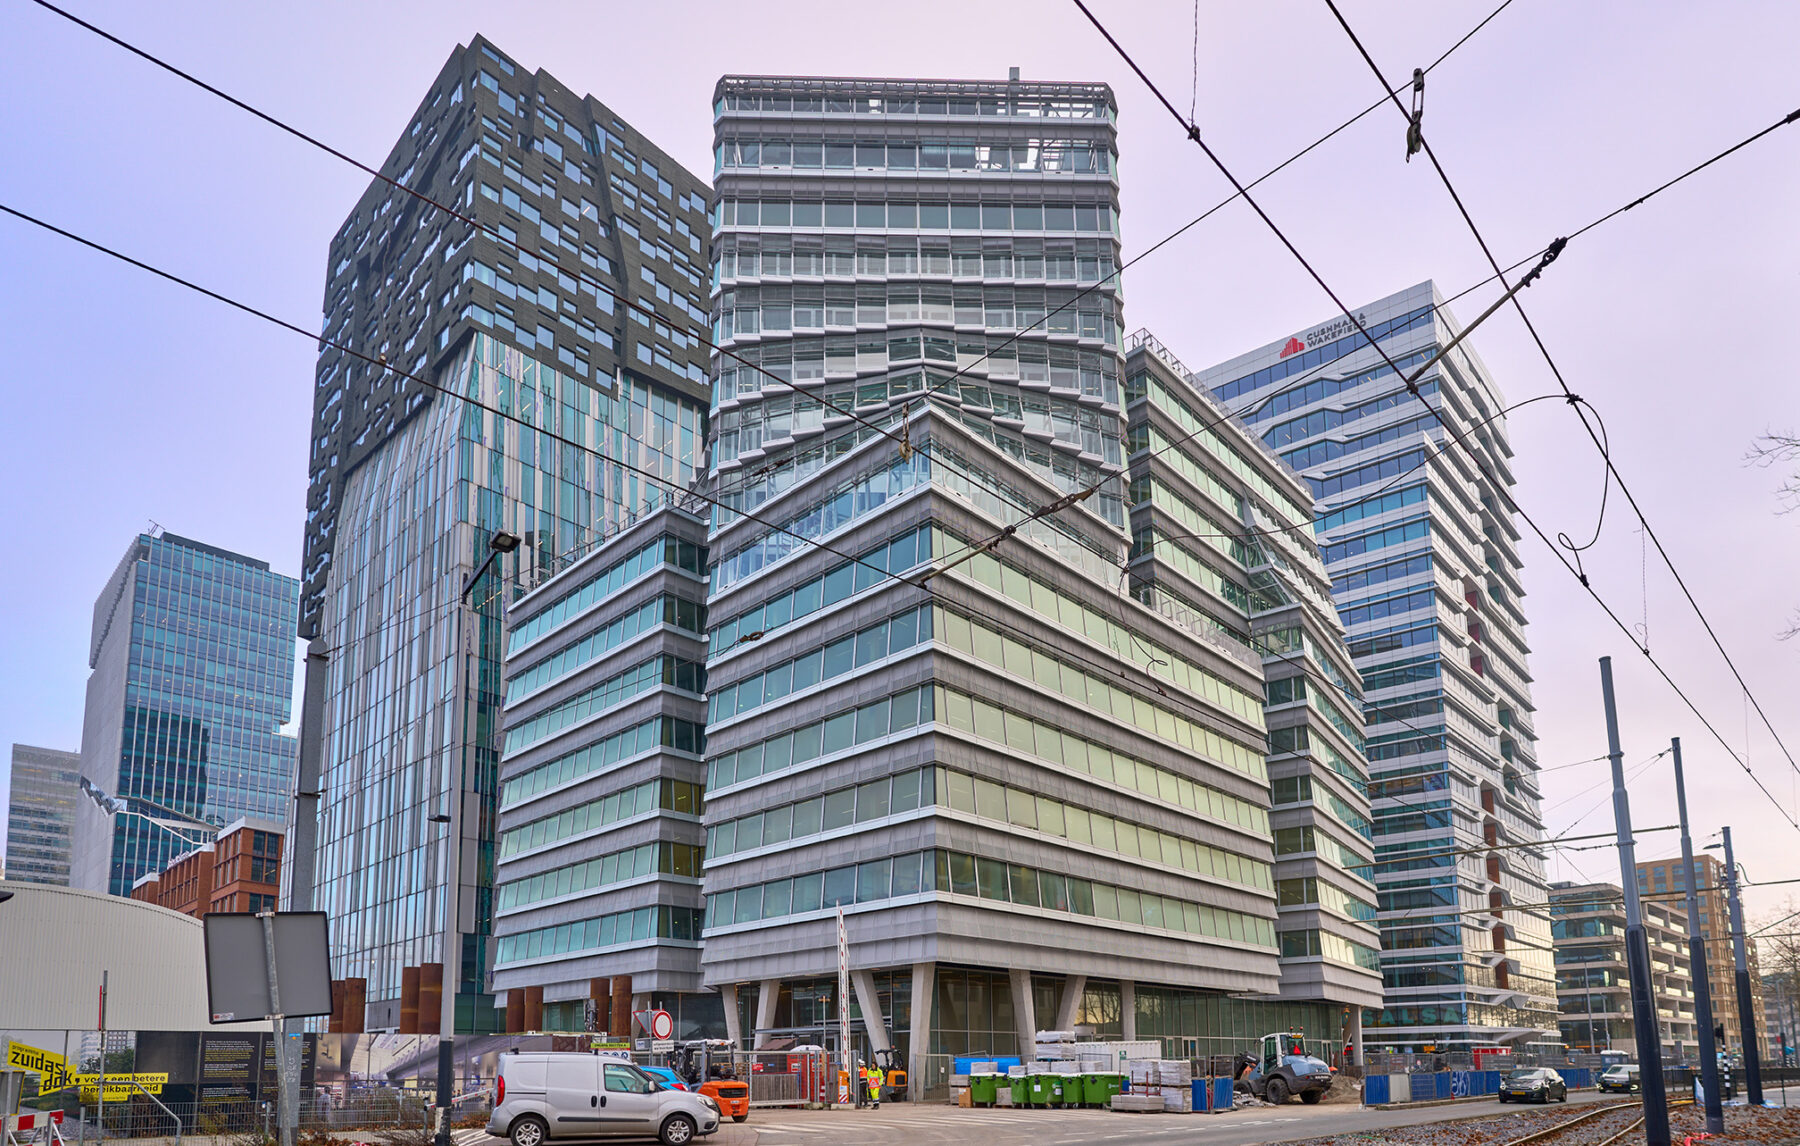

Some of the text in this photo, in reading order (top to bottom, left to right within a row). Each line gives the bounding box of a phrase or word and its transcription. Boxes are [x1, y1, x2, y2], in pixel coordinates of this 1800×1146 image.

[1307, 320, 1367, 348] WAKEFIELD
[1361, 1006, 1460, 1026] SALSA
[11, 1051, 65, 1076] zuidas
